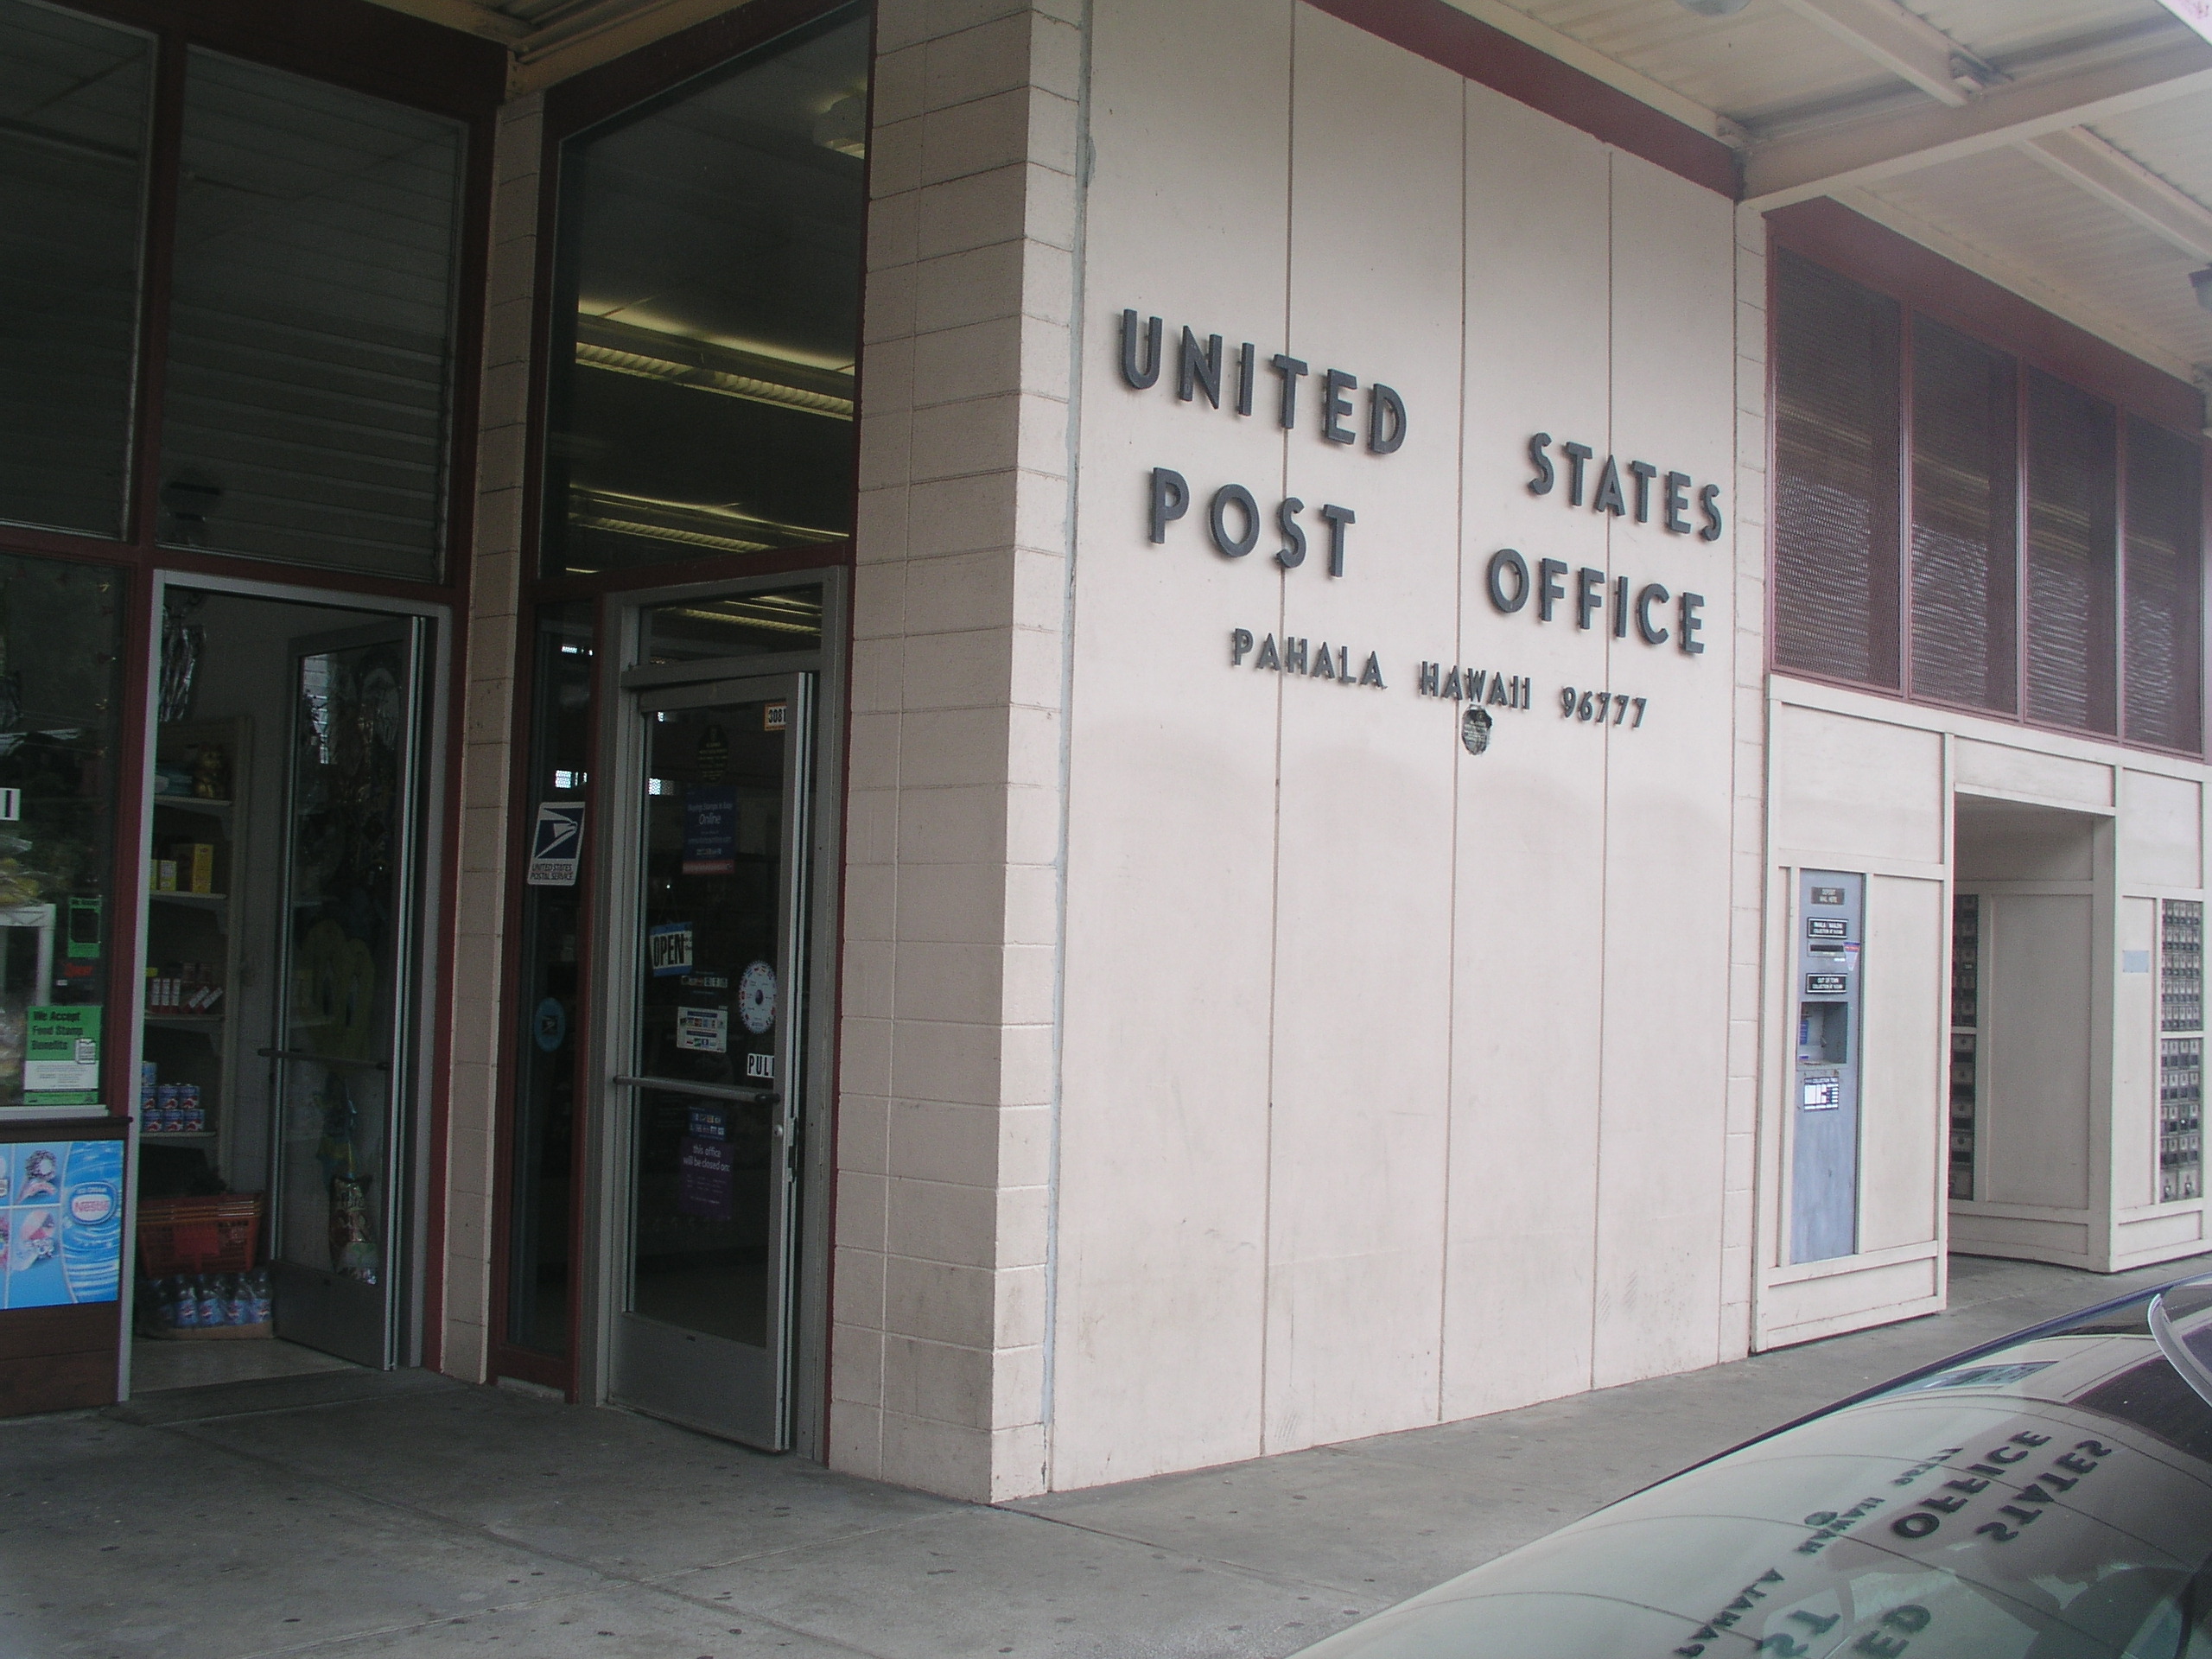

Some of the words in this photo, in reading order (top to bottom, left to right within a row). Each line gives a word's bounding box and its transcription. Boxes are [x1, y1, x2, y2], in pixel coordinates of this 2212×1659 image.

[1118, 308, 1408, 454] UNITED
[1528, 431, 1723, 543] STATES
[1148, 467, 1356, 577] POST
[1488, 548, 1706, 654] OFFICE
[1420, 659, 1531, 710] HAWAII
[1560, 685, 1647, 728] 96777
[652, 934, 685, 968] OPEN
[32, 1025, 54, 1036] Food
[55, 1025, 84, 1037] Stamp
[33, 1011, 48, 1021] We
[48, 1011, 81, 1023] Accept
[704, 1146, 721, 1158] office
